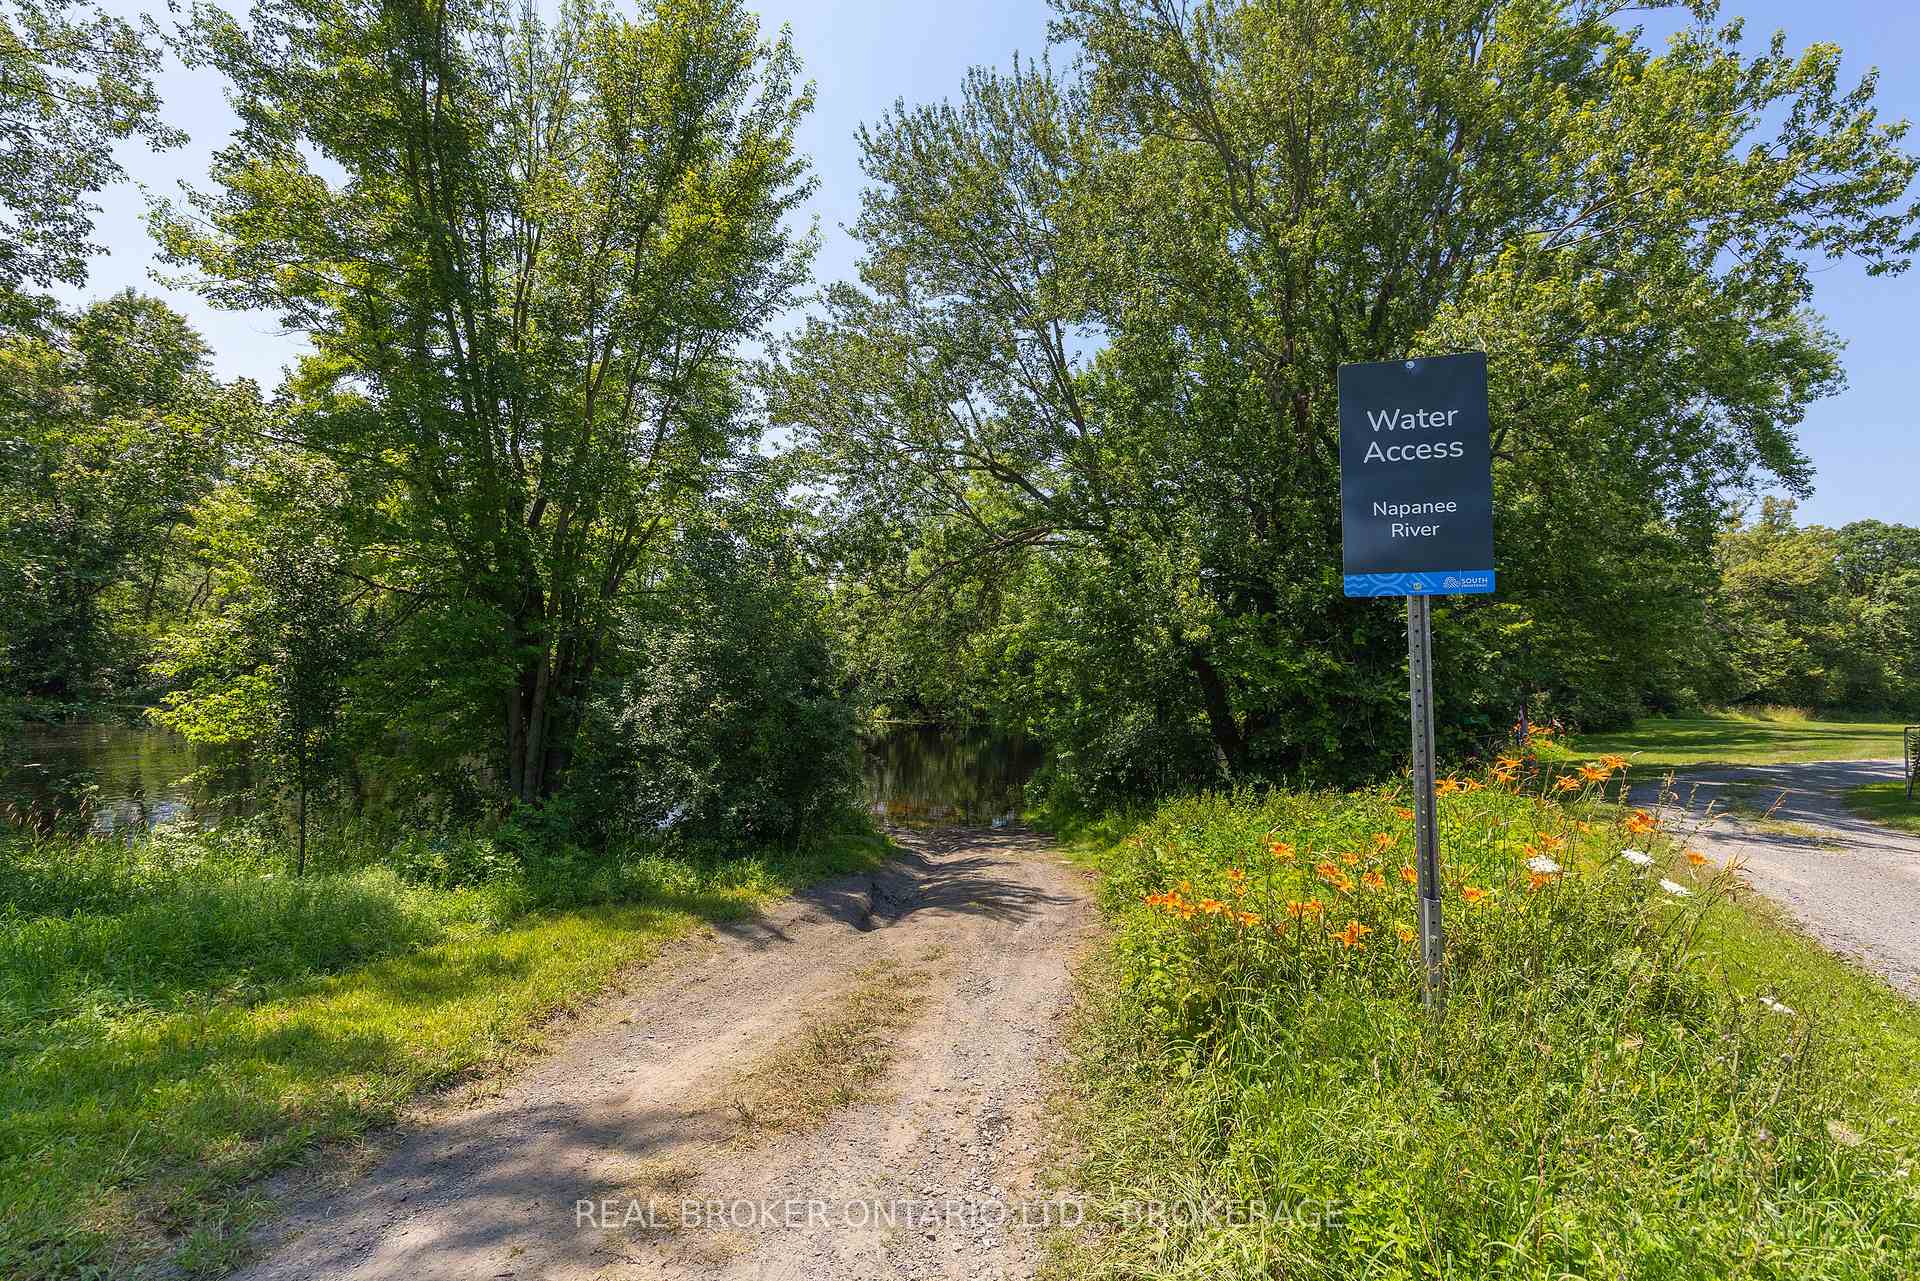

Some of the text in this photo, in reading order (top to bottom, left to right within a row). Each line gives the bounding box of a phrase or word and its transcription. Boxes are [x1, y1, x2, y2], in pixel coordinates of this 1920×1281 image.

[1367, 408, 1459, 432] Water
[1363, 441, 1464, 463] Access
[1373, 500, 1457, 518] Napanee
[1391, 522, 1440, 538] River
